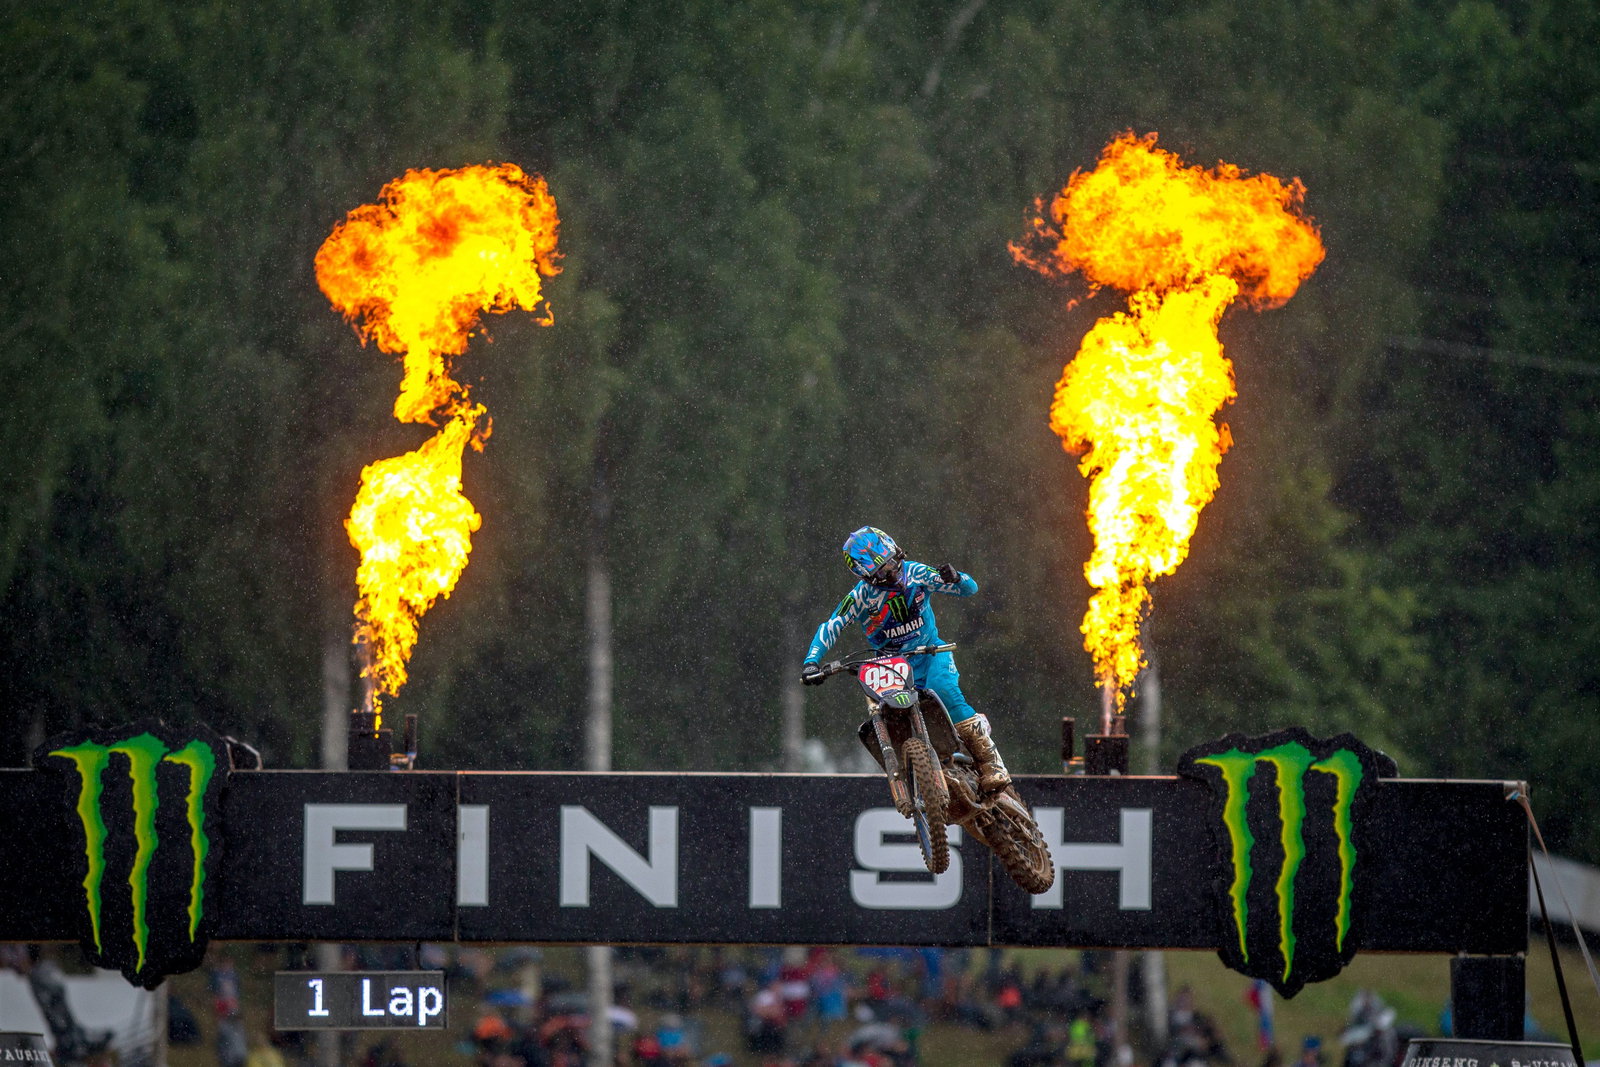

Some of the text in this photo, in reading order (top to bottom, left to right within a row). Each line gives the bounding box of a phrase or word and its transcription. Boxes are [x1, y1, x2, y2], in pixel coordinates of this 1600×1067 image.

[884, 617, 924, 638] YAMAHA
[865, 663, 908, 691] 959
[303, 803, 1152, 910] FINISH
[308, 979, 443, 1026] 1 Lap
